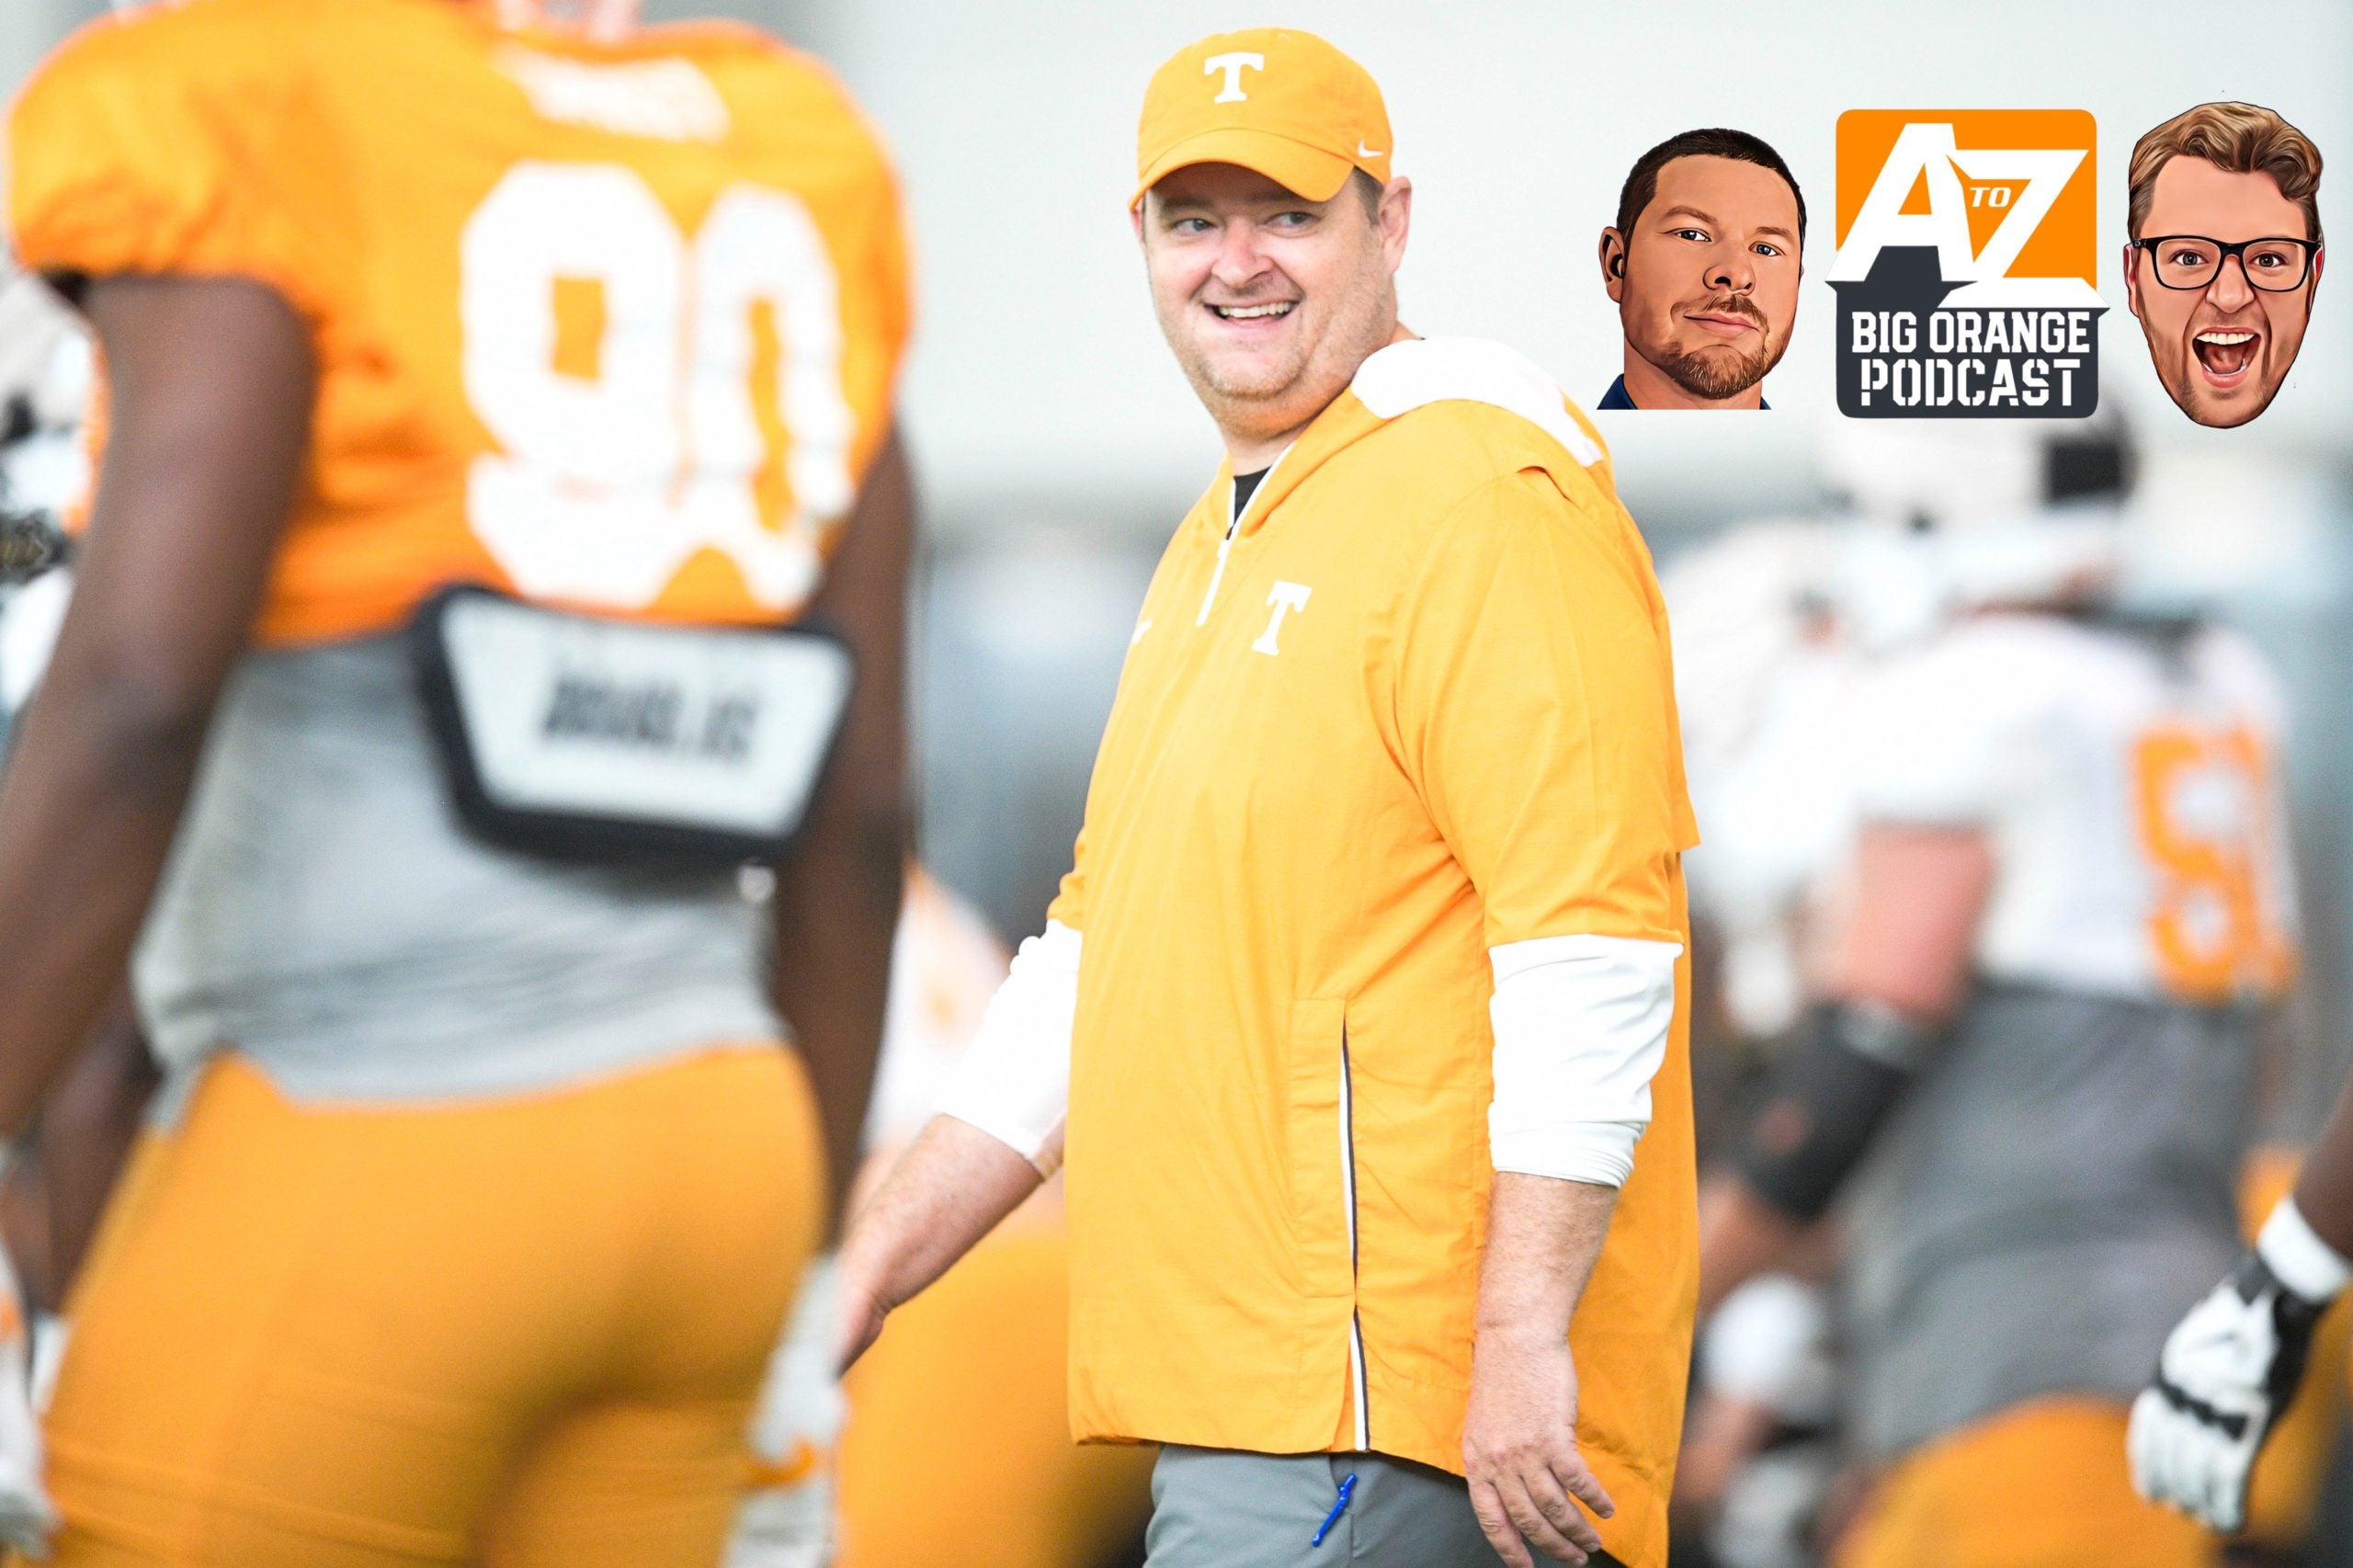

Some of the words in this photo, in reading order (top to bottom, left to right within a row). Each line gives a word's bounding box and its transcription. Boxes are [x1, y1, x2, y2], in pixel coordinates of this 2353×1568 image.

[1204, 51, 1265, 104] T
[461, 158, 857, 612] 90
[1251, 580, 1313, 656] T
